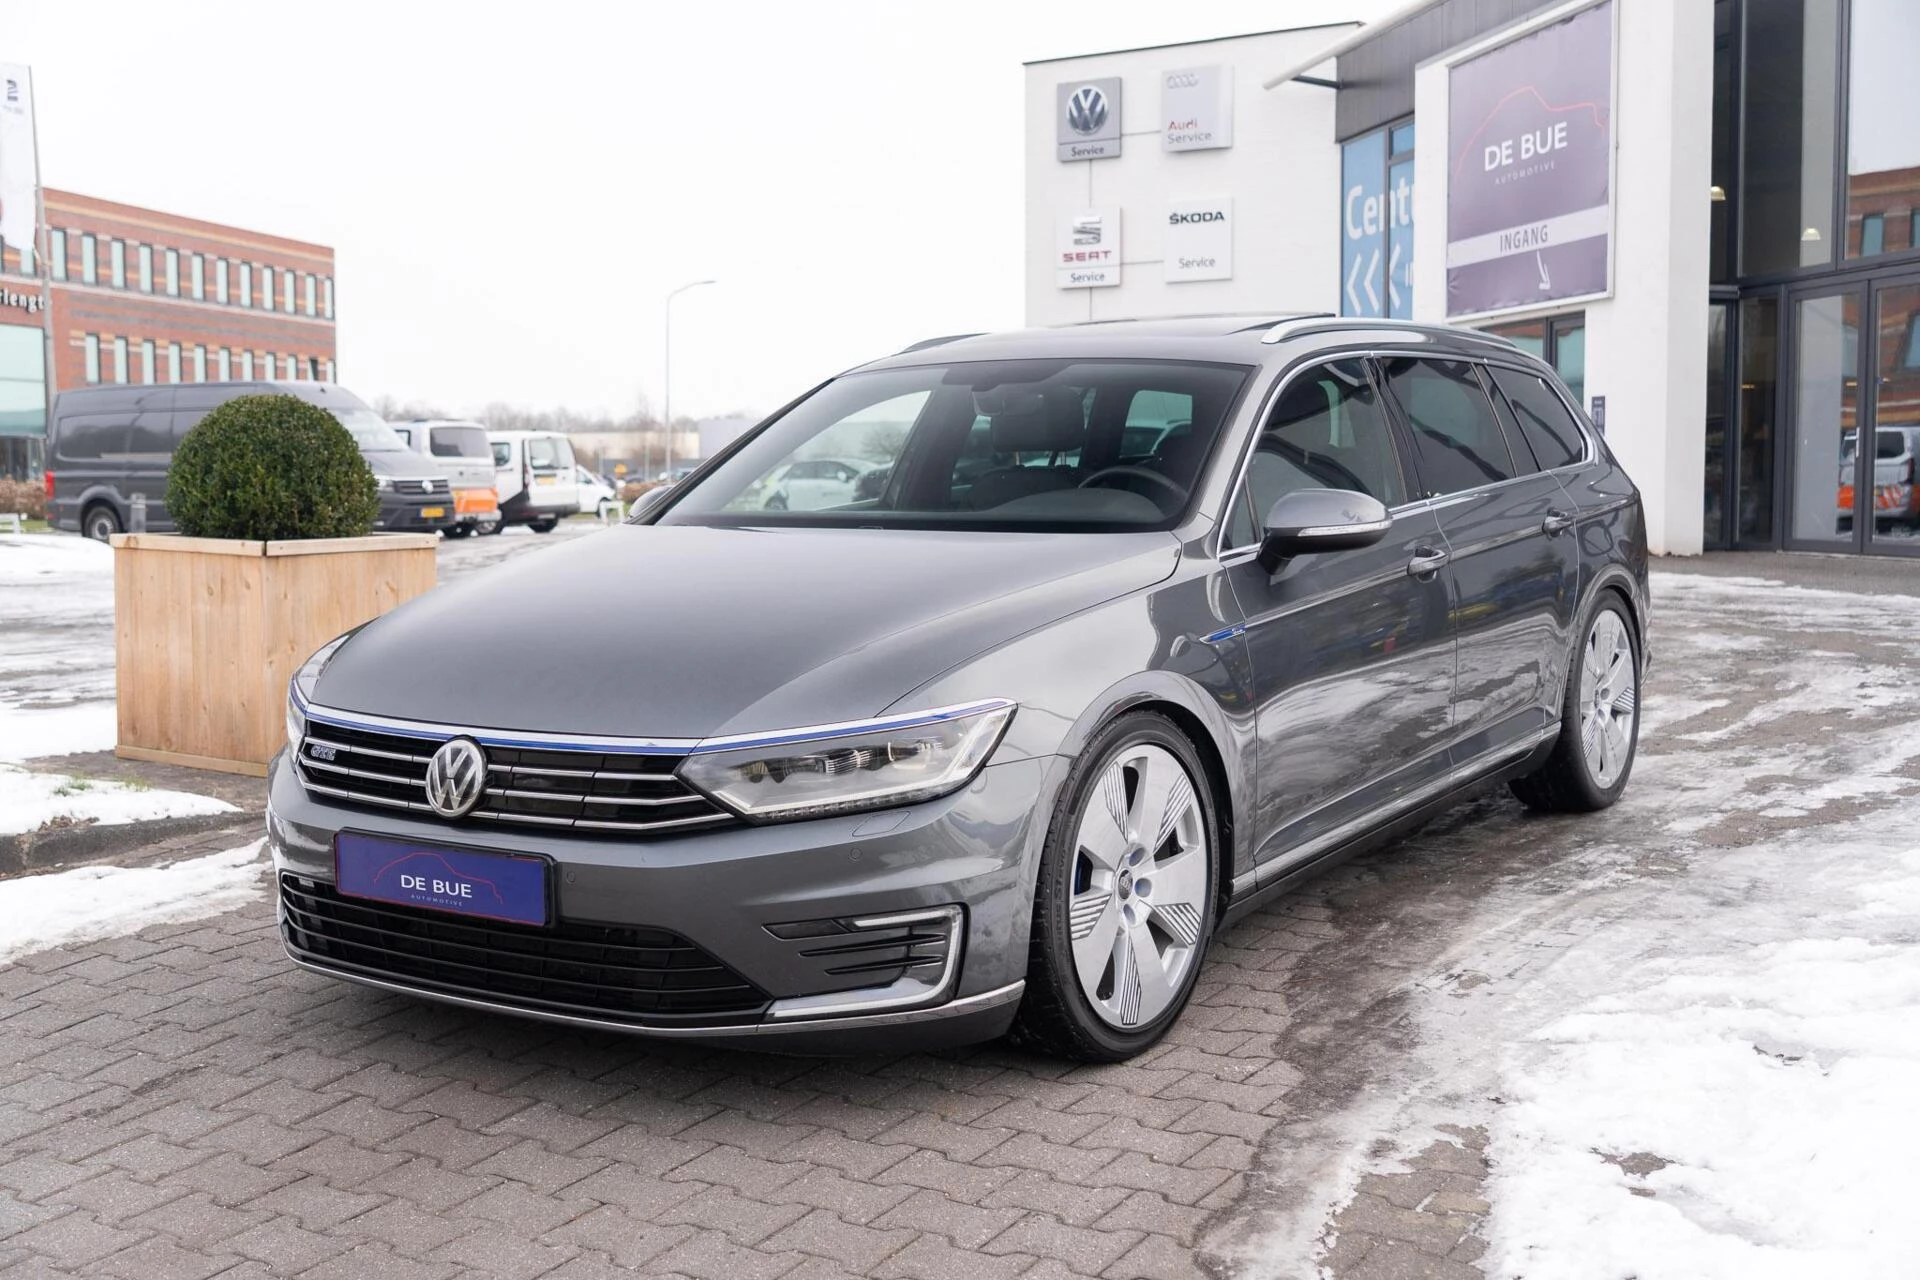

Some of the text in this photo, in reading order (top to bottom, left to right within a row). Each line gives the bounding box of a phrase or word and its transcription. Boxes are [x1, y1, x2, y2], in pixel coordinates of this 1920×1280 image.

[1168, 118, 1197, 130] Audi
[1168, 131, 1212, 144] Service
[1071, 146, 1105, 157] Service
[1484, 121, 1568, 171] DE BUE
[1494, 160, 1555, 185] AUTOMOTIVE
[1169, 211, 1225, 225] ŠKODA
[1500, 223, 1548, 252] INGANG
[1063, 250, 1112, 263] SEAT
[1179, 256, 1216, 269] Service
[1070, 271, 1105, 283] Service
[400, 874, 473, 898] DE BUE
[410, 893, 463, 907] AUTOMOTIVE
